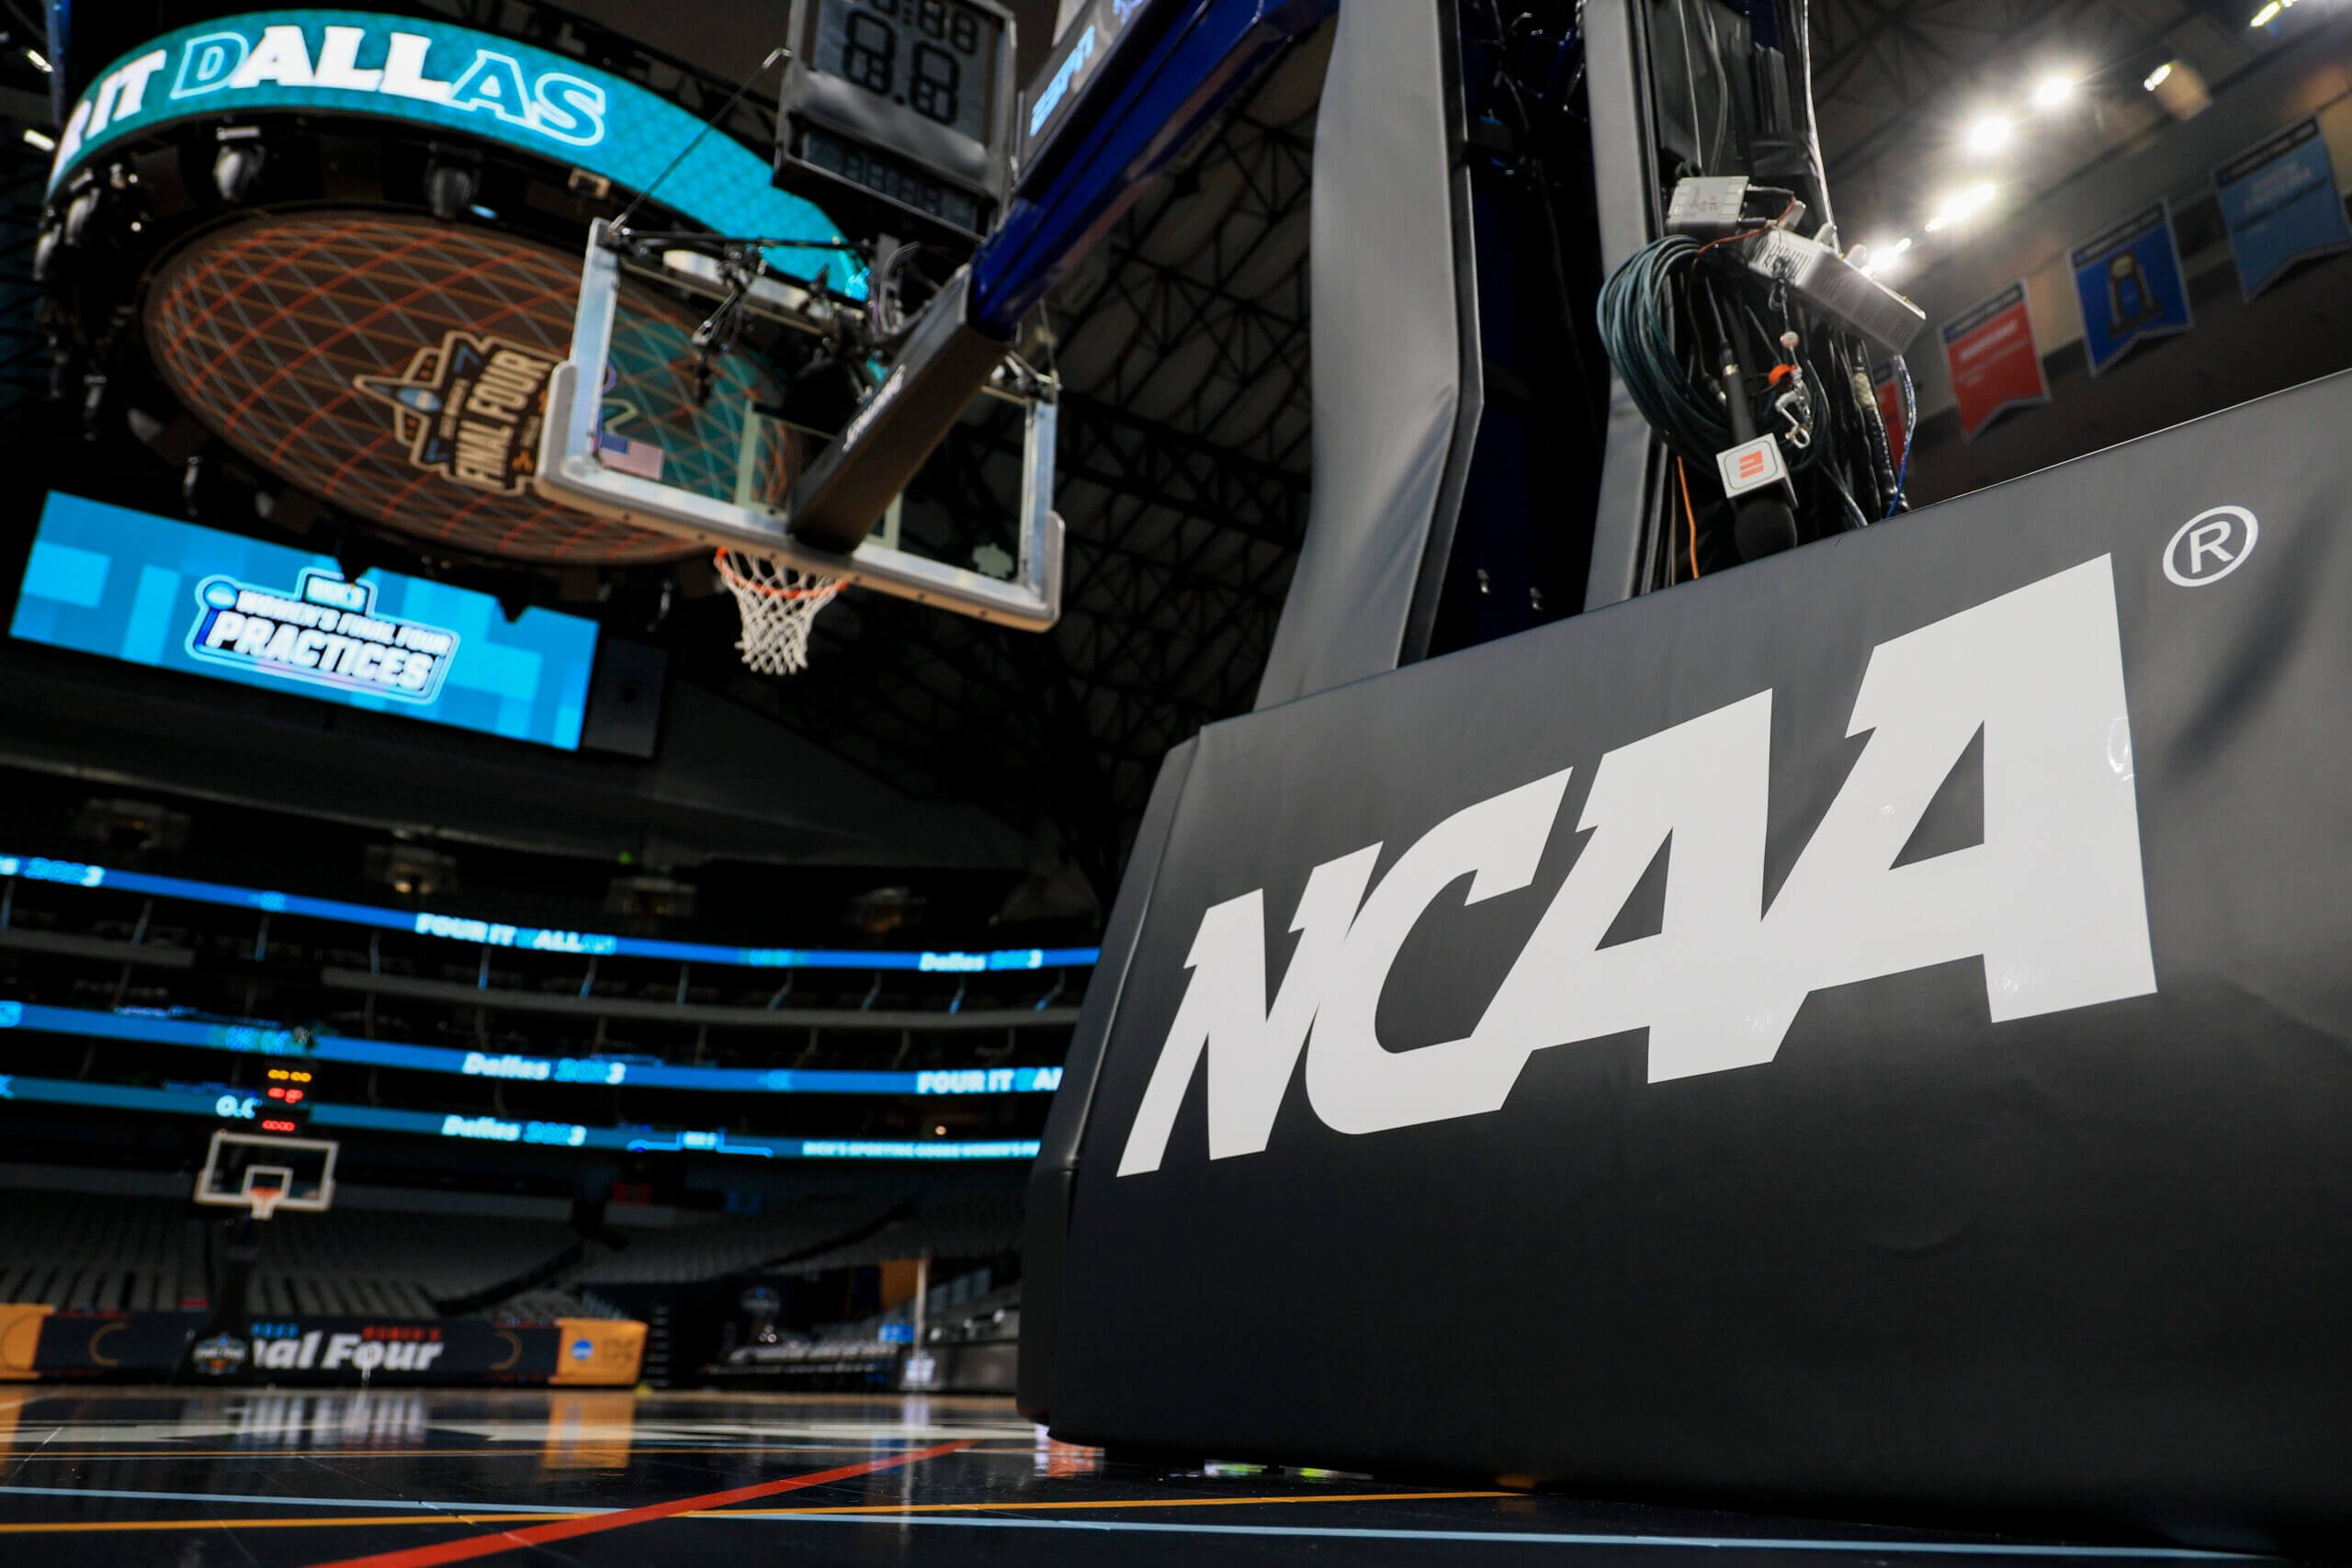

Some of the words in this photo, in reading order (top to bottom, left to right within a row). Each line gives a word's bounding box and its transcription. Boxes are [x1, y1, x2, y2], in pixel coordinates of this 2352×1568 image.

[169, 25, 605, 147] DALLAS
[466, 349, 552, 423] FOUR
[455, 419, 514, 490] FINAL
[204, 610, 435, 691] PRACTICES
[1116, 552, 2157, 1179] NCAA
[917, 1070, 986, 1095] FOUR
[987, 1068, 1014, 1093] IT
[322, 1332, 445, 1371] Four
